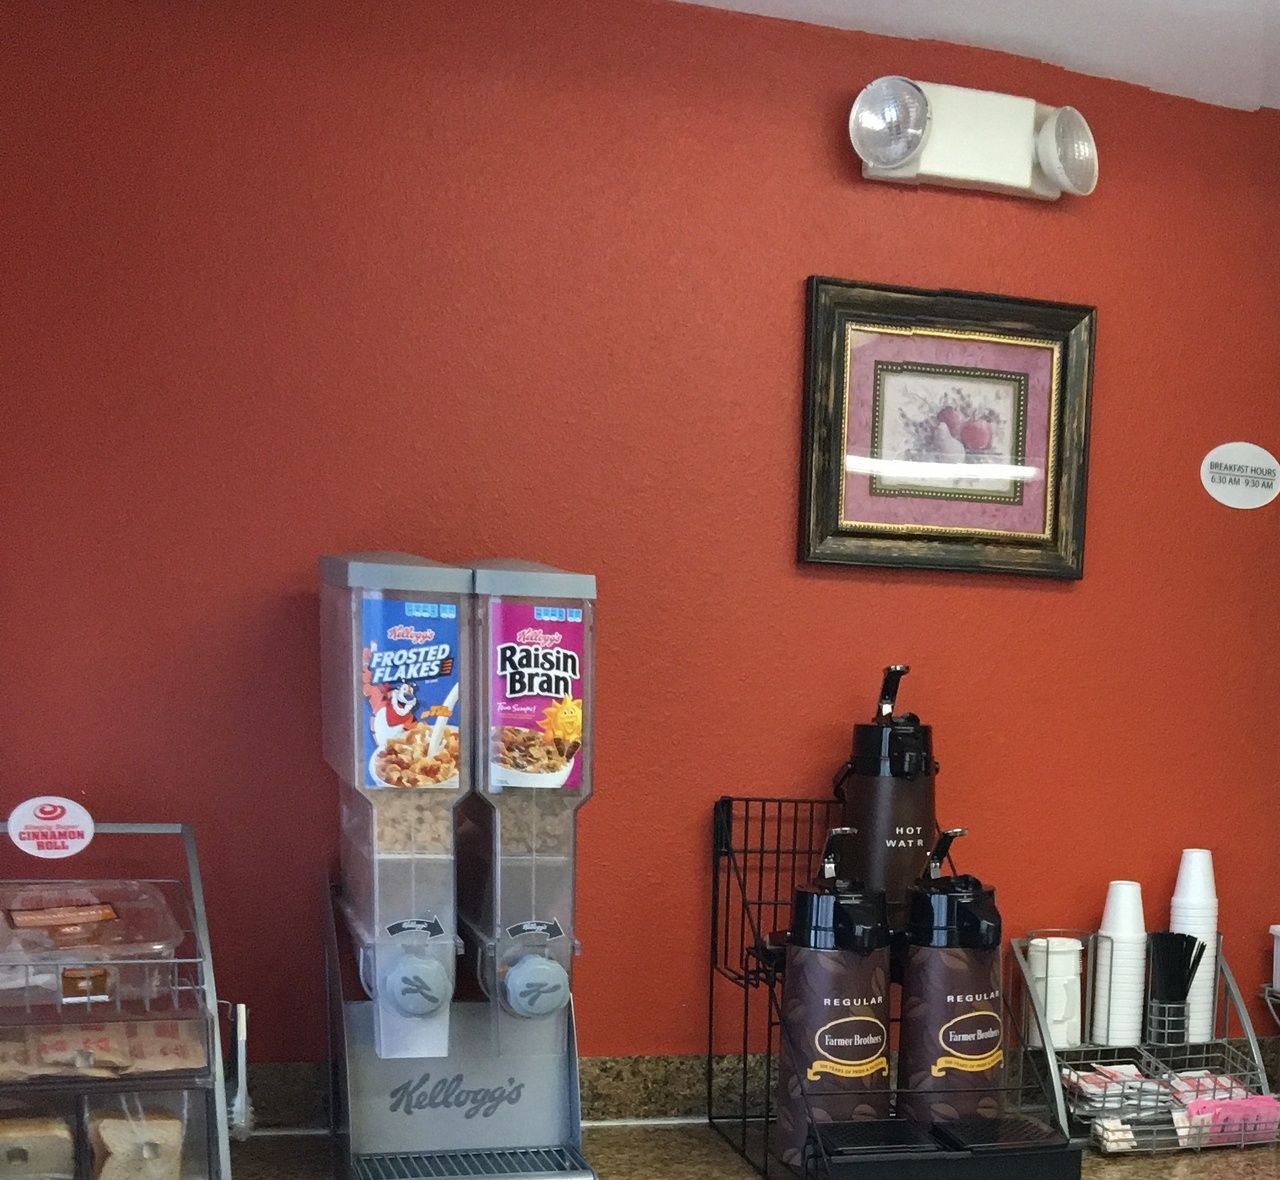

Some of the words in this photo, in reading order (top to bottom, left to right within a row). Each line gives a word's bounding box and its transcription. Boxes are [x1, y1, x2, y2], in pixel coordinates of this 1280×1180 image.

[1209, 461, 1249, 474] BREAKFAST
[1250, 467, 1277, 477] HOURS
[1261, 481, 1274, 489] AM
[387, 624, 435, 644] Kellogg's
[516, 628, 562, 647] Kellogg's
[370, 644, 450, 668] FROSTED
[498, 646, 579, 677] Raisin
[372, 660, 441, 683] FLAKES
[509, 671, 570, 697] Bran
[18, 830, 85, 841] CINNAMON
[37, 841, 69, 851] ROLL
[824, 996, 883, 1006] REGULAR
[825, 1034, 853, 1046] Farmer
[854, 1034, 882, 1045] Brothers
[949, 1031, 976, 1041] Farmer
[389, 1073, 525, 1119] Kellogg's
